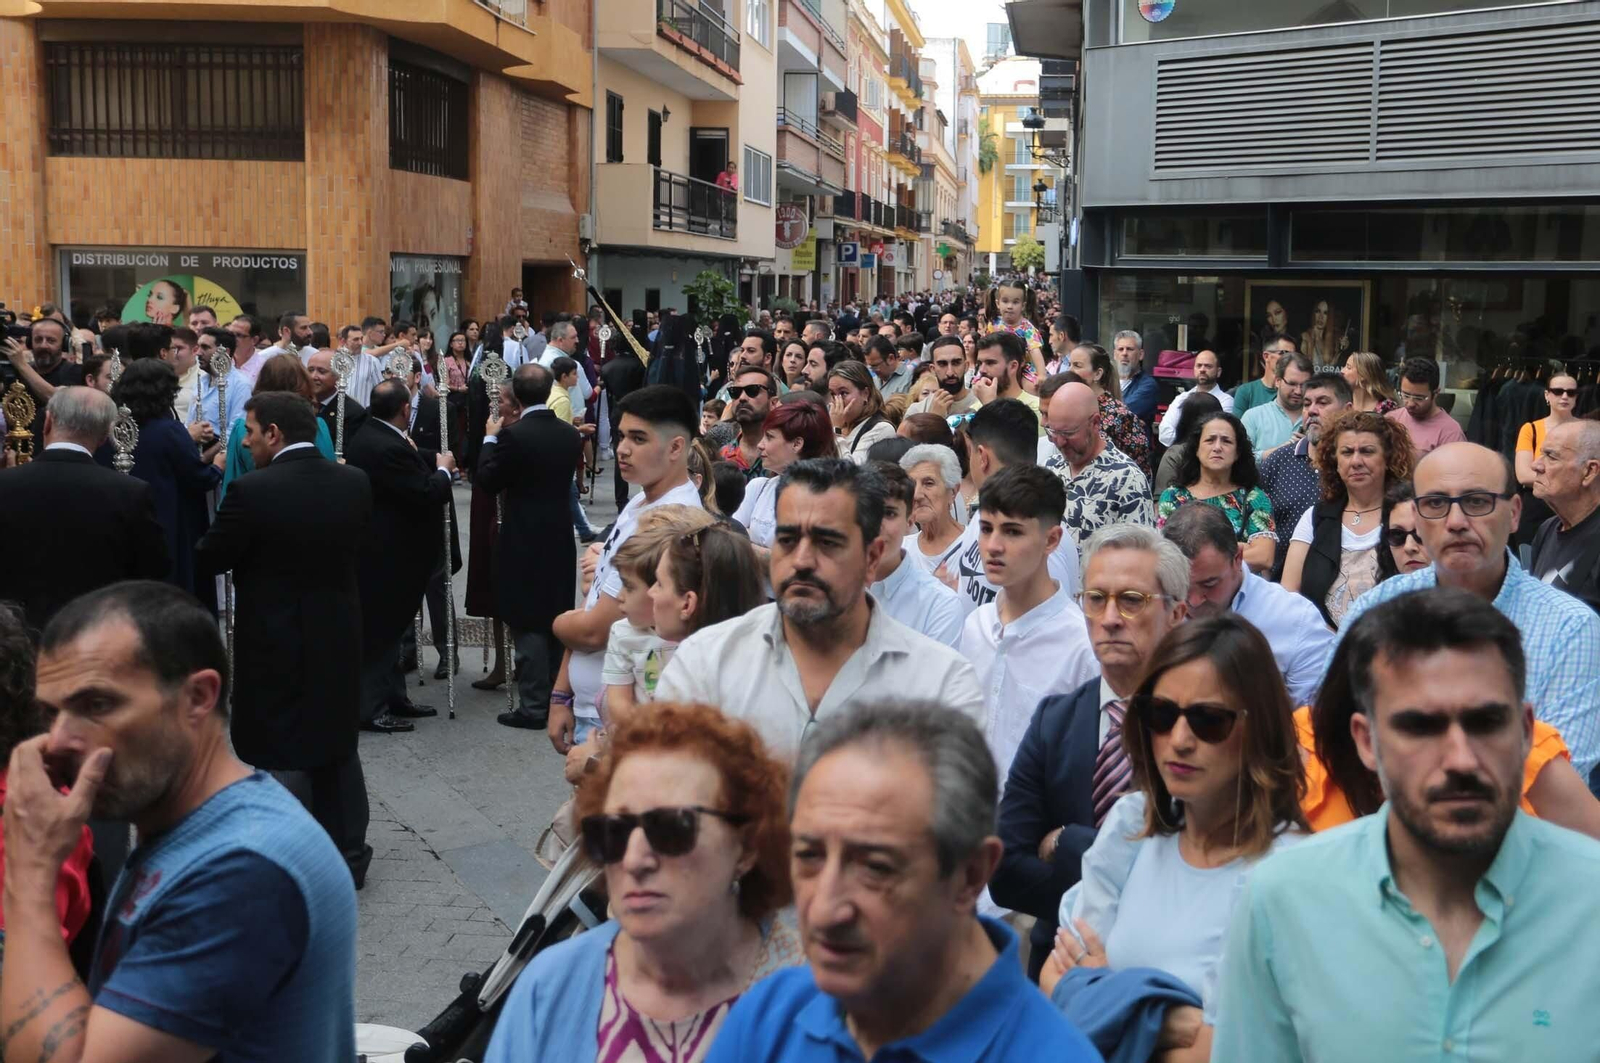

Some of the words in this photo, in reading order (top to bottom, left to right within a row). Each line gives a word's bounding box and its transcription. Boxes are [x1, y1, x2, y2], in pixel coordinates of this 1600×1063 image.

[841, 244, 854, 262] P
[72, 252, 169, 267] DISTRIBUCIÓN
[180, 255, 200, 267] DE
[212, 256, 298, 270] PRODUCTOS
[415, 260, 462, 273] PROFESIONAL
[1169, 314, 1180, 324] ghd
